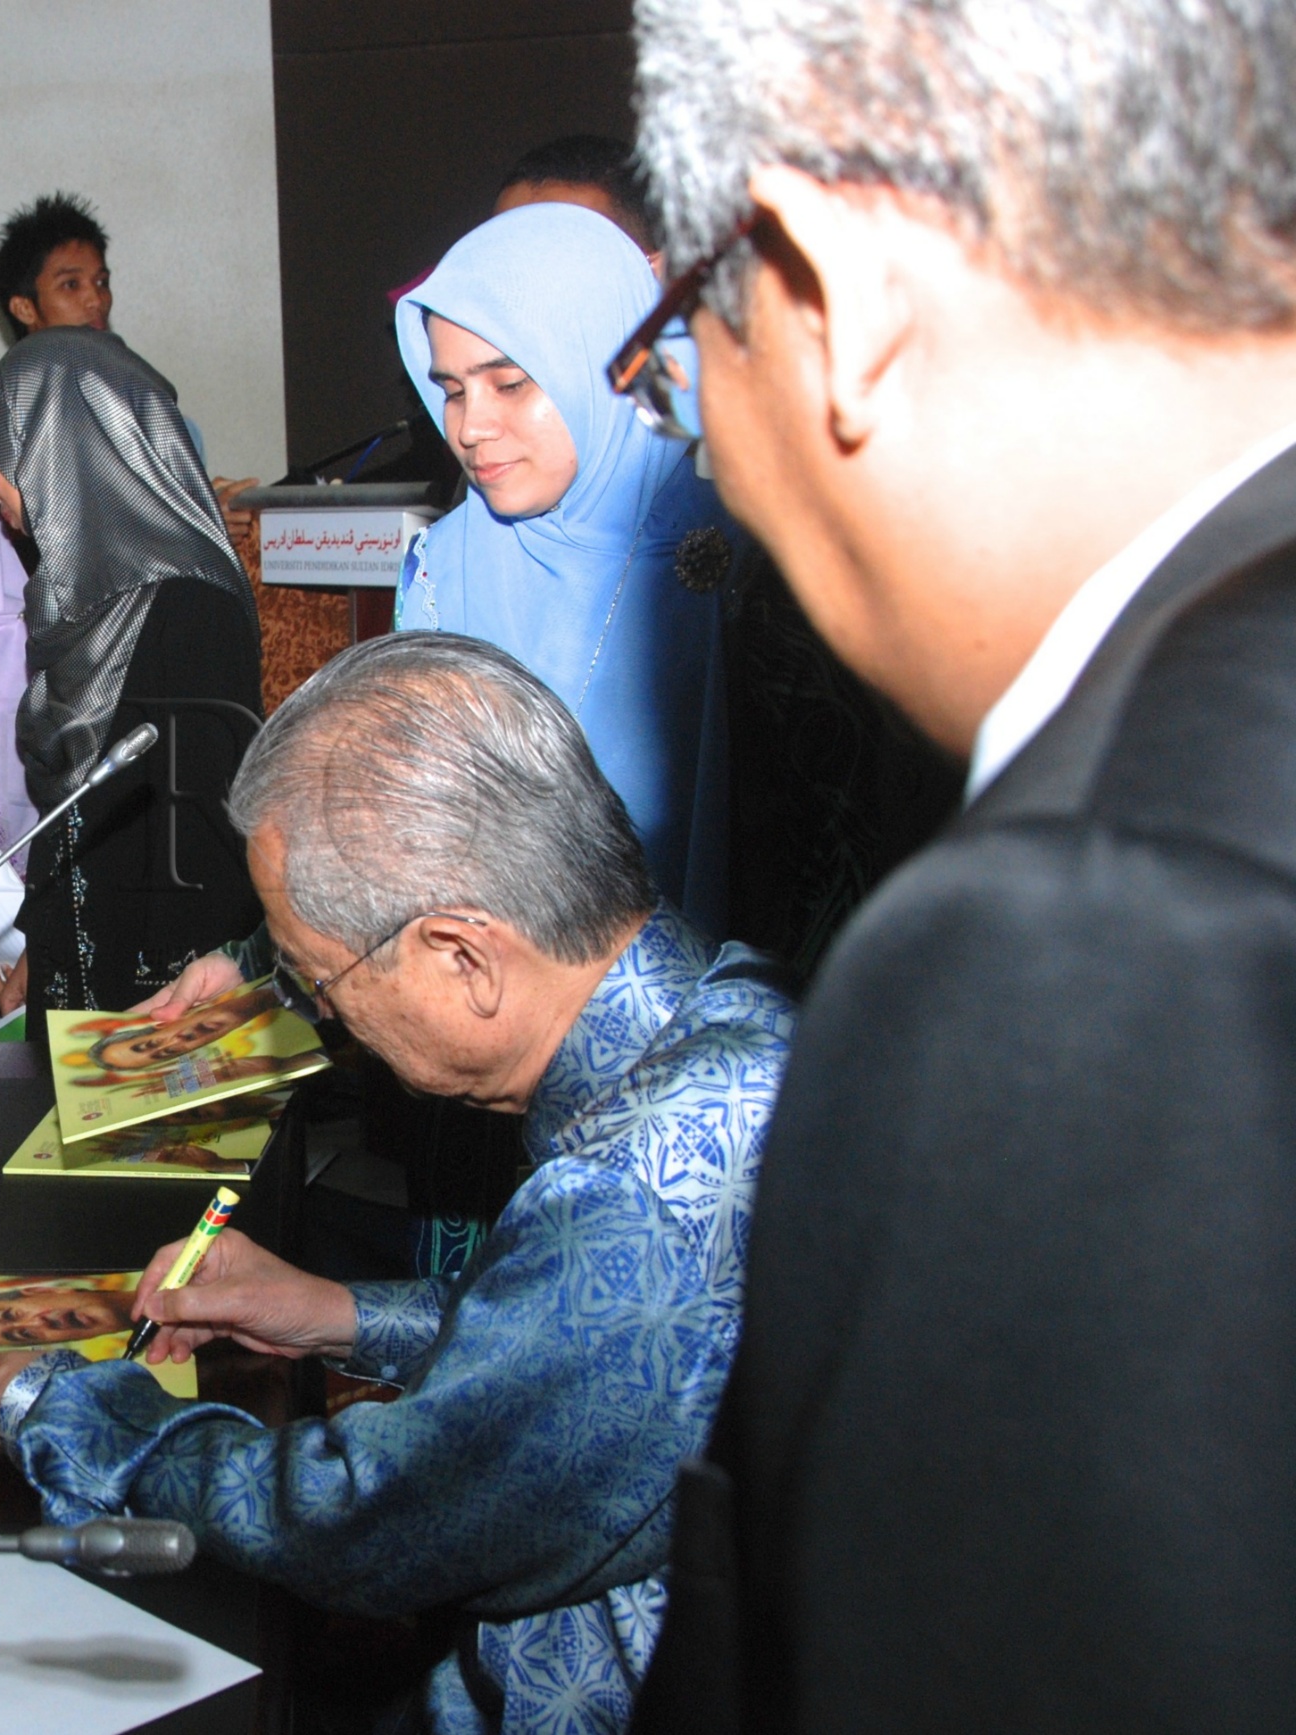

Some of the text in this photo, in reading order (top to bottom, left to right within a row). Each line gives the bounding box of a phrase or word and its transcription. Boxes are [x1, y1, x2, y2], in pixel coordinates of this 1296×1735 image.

[263, 560, 302, 571] UNIVERSITI
[304, 560, 350, 572] PENDIDIKAN
[351, 561, 379, 572] SULTAN
